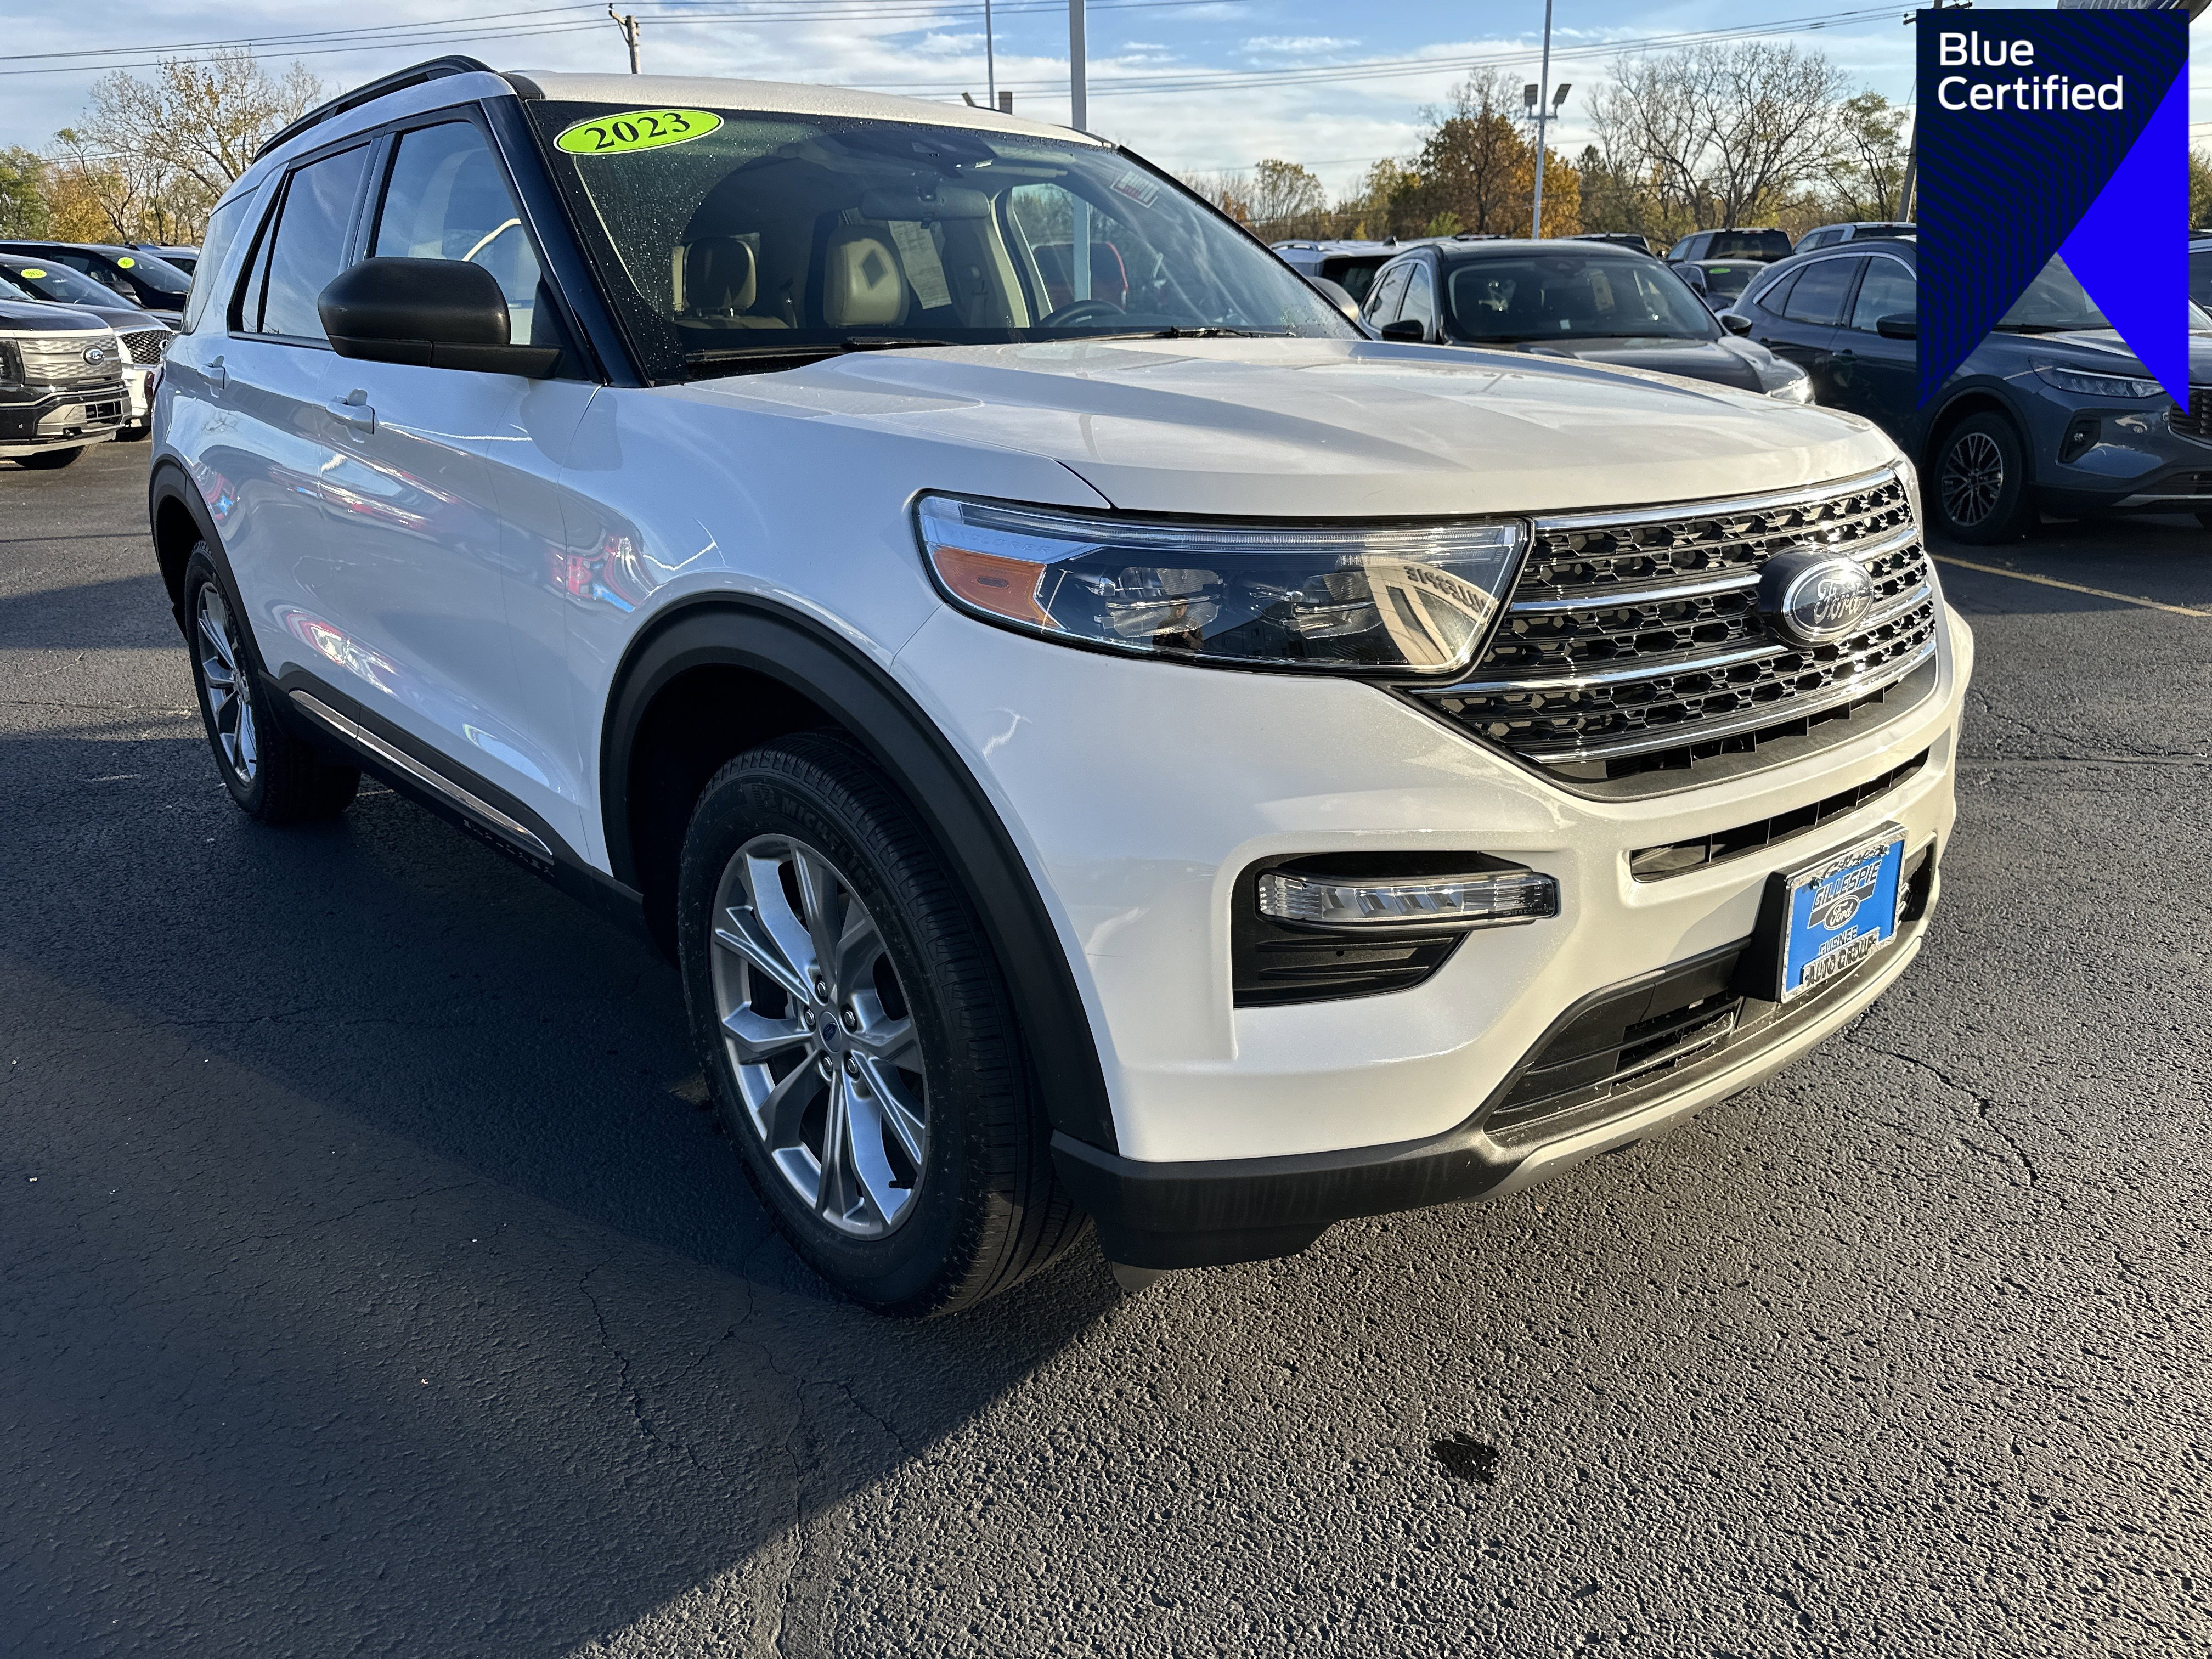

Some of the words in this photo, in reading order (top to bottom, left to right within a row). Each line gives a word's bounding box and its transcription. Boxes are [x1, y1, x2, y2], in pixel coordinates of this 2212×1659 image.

[584, 113, 690, 150] 2023
[1814, 579, 1864, 624] Ford
[781, 796, 874, 894] MICHELIN
[1813, 860, 1882, 910] GILLESPIE
[1830, 902, 1853, 927] Ford
[1819, 926, 1858, 955] GURNEE
[1807, 953, 1835, 987] AUTO
